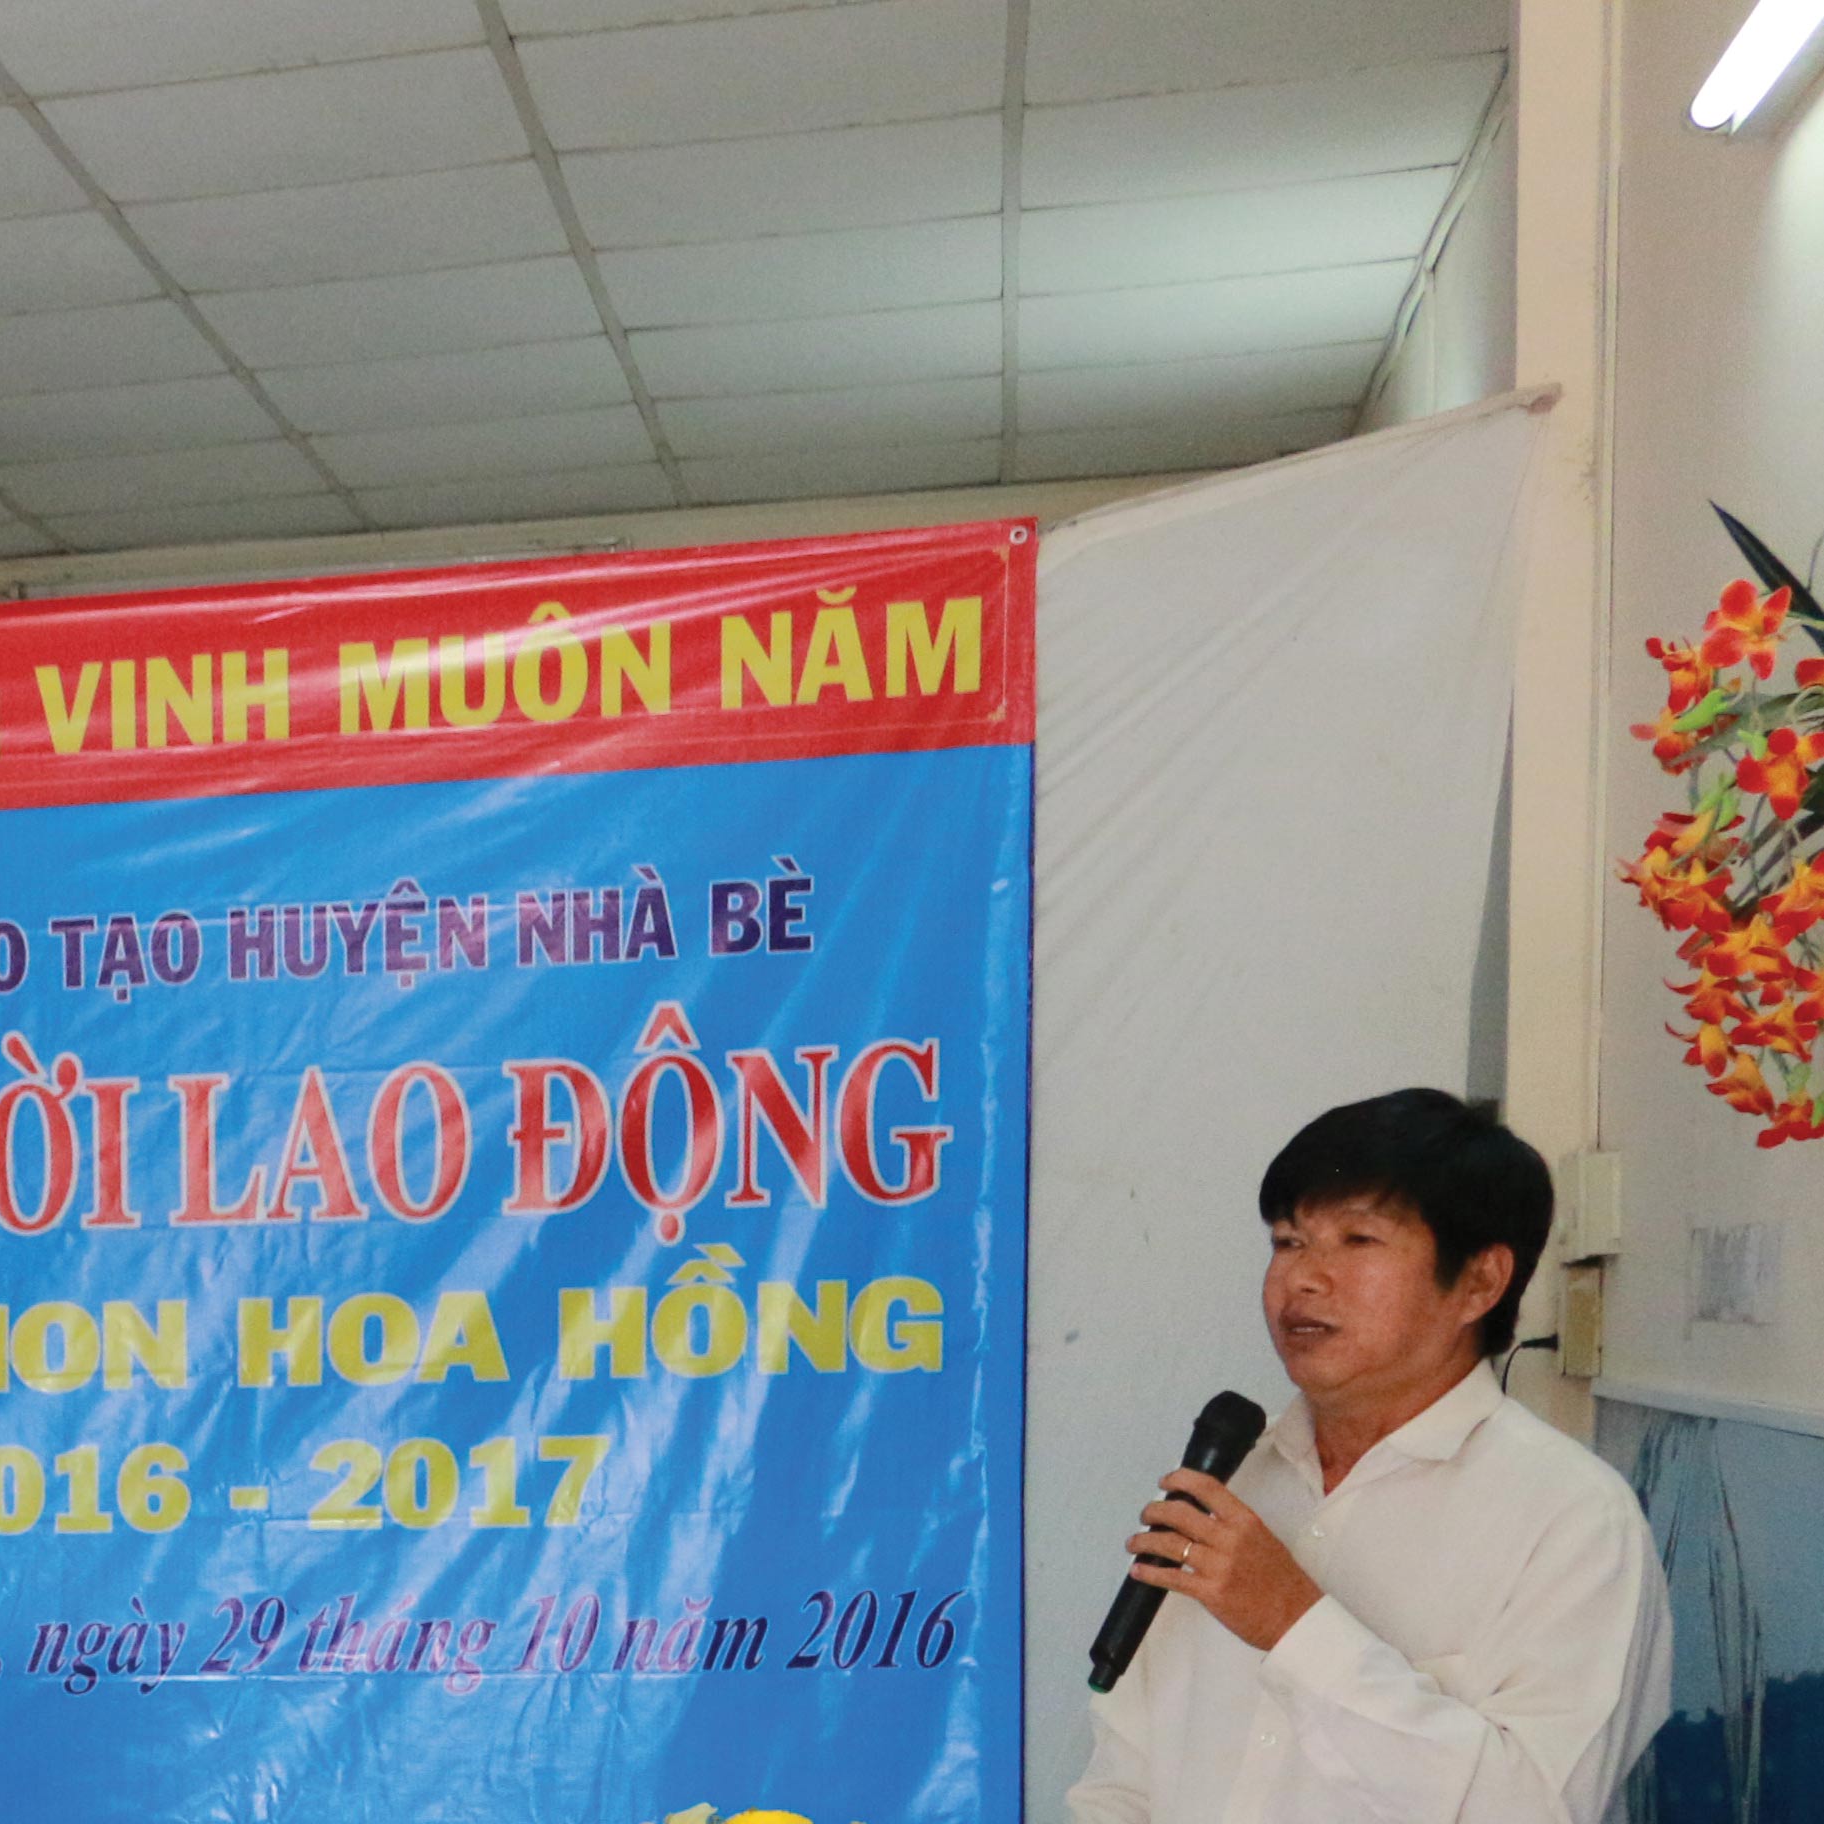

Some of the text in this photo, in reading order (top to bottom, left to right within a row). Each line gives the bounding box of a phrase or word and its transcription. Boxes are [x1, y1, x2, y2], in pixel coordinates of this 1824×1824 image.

[34, 648, 290, 752] VINH
[338, 604, 676, 736] MUÔN
[720, 584, 983, 708] NĂM
[50, 912, 201, 1005] TẠO
[226, 880, 488, 989] HUYỆN
[515, 864, 677, 965] NHÀ
[709, 855, 814, 954] BÈ
[168, 1062, 472, 1226] LAO
[501, 1002, 952, 1245] ĐỘNG
[237, 1292, 509, 1386] HOA
[558, 1242, 945, 1380] HỒNG
[307, 1433, 611, 1530] 2017
[27, 1594, 185, 1694] ngày
[198, 1598, 286, 1673] 29
[296, 1594, 497, 1694] tháng
[517, 1594, 604, 1672] 10
[612, 1594, 767, 1670] năm
[786, 1589, 963, 1672] 2016
